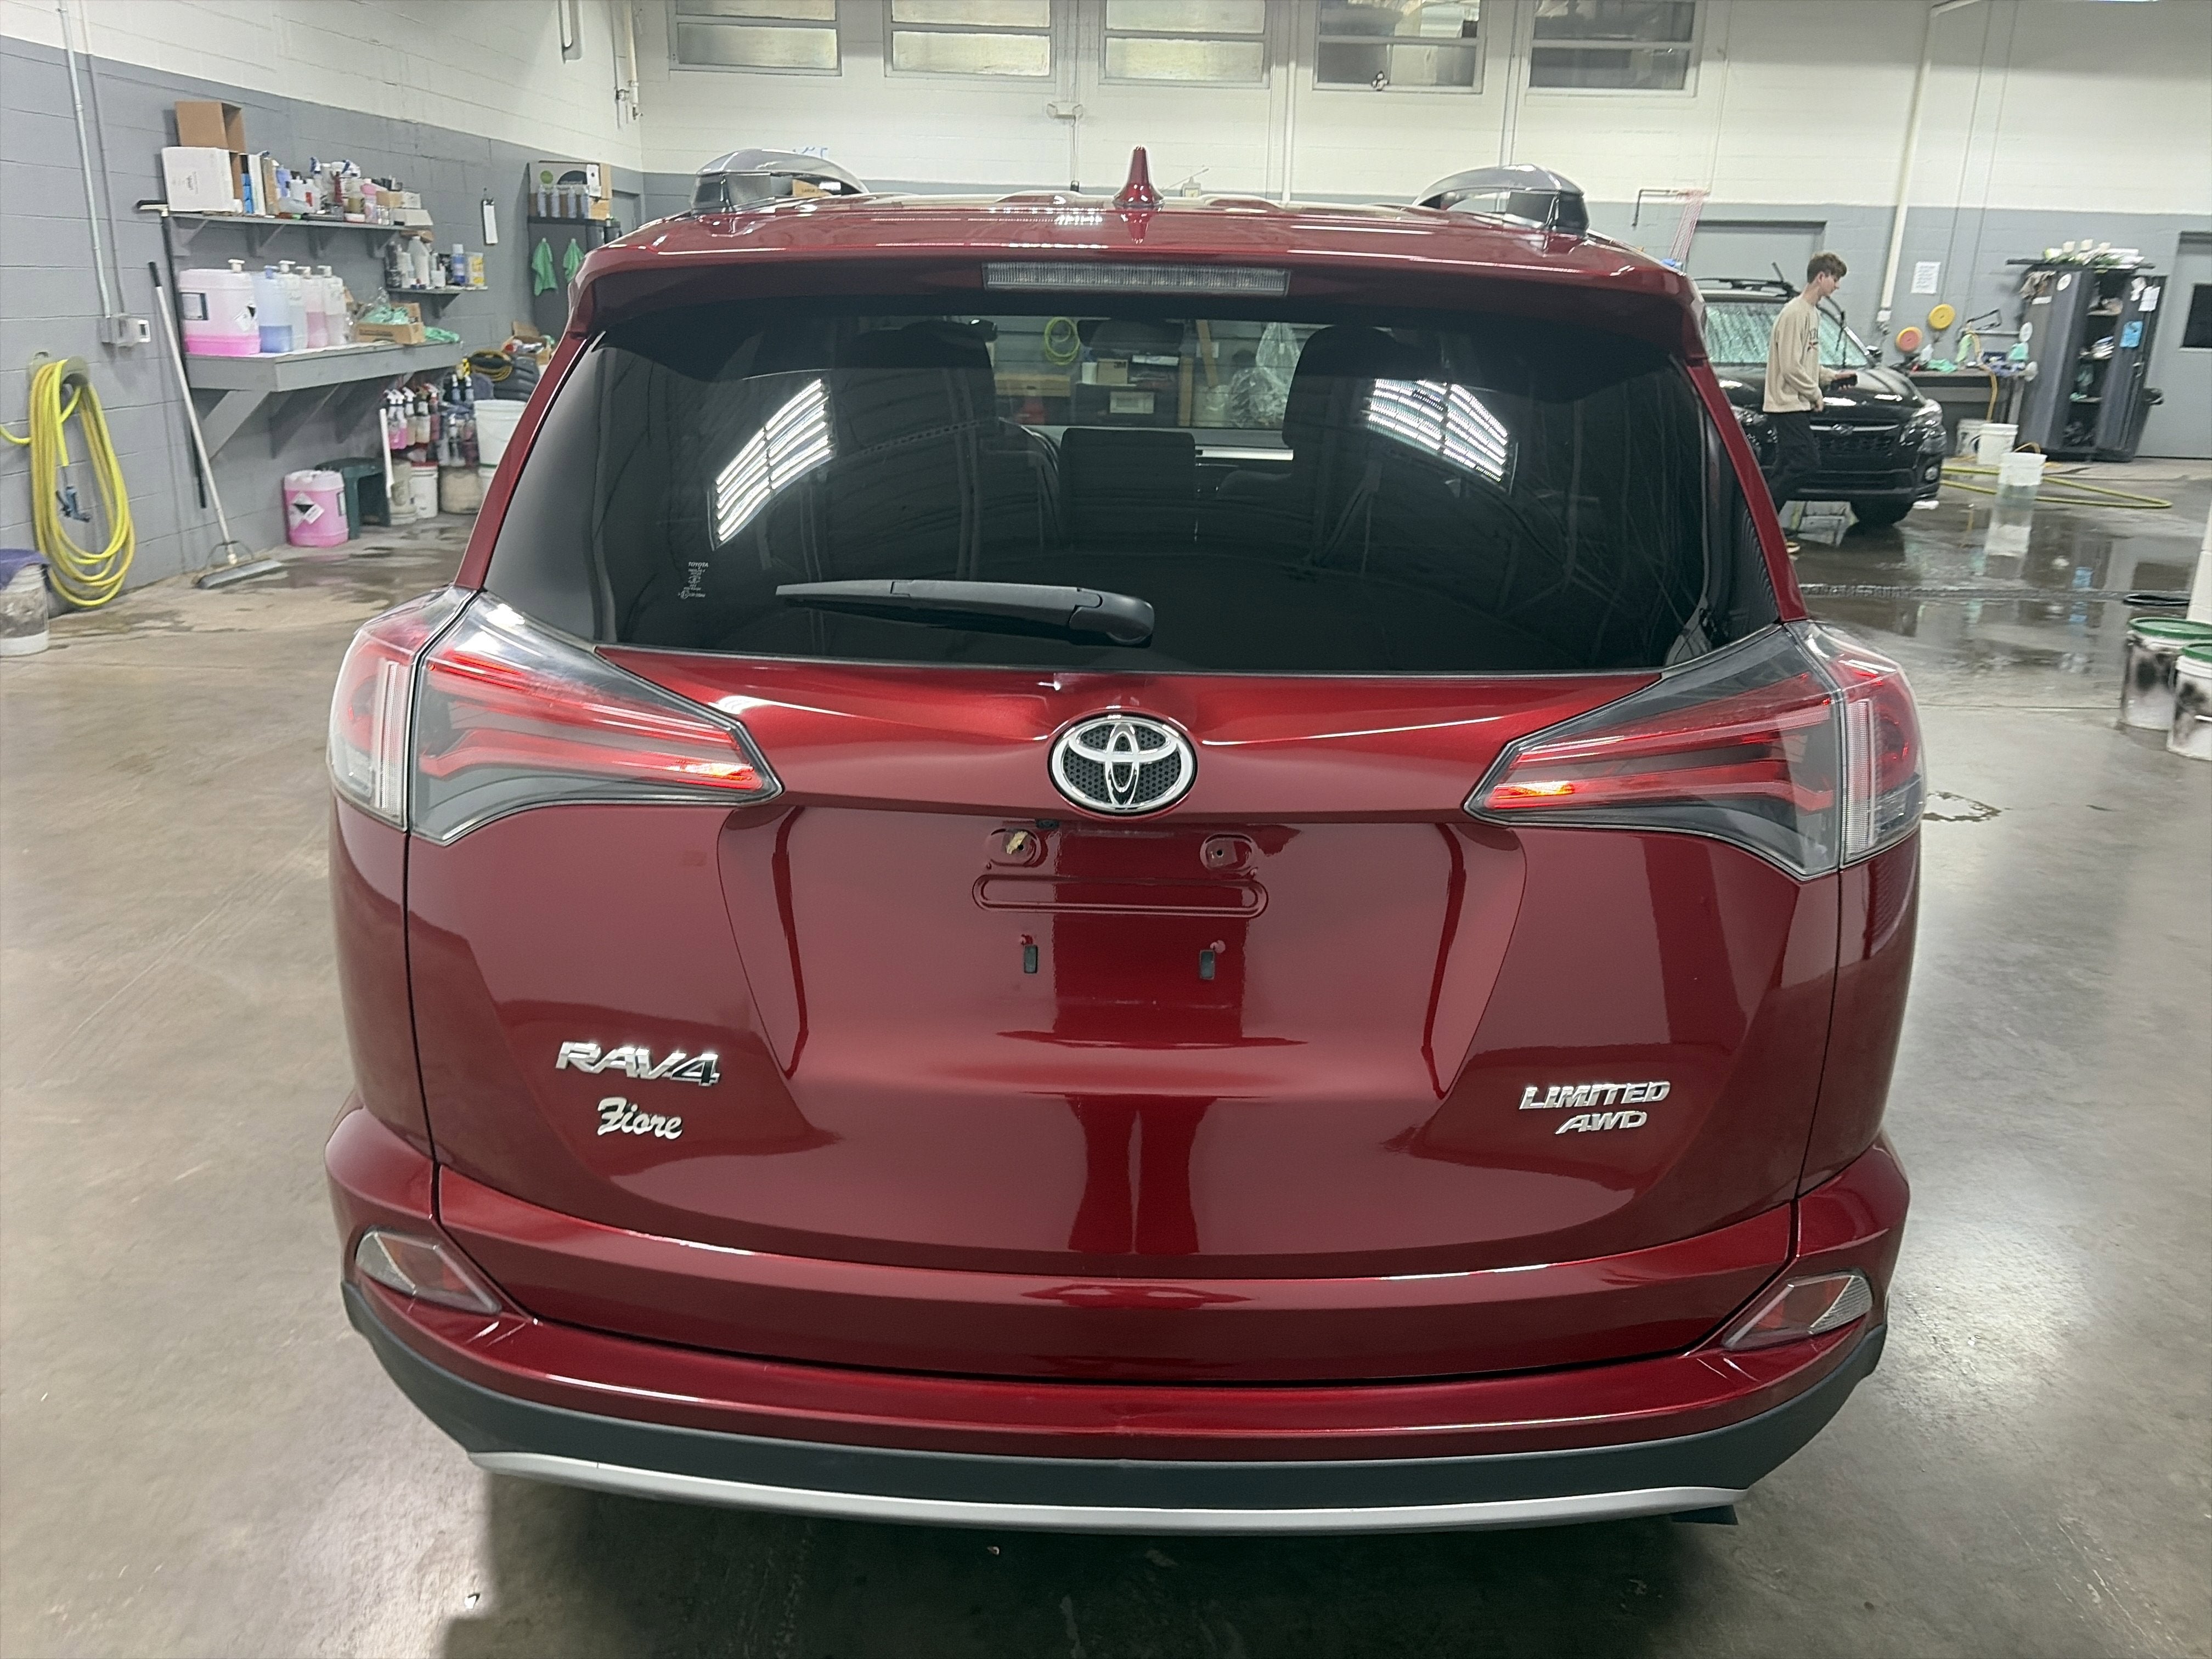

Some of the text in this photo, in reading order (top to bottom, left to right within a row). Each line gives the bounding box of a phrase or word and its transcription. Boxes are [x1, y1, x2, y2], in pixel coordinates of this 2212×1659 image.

[555, 1041, 720, 1086] RAV4
[1519, 1081, 1671, 1109] LIMITED
[597, 1097, 682, 1139] Fiore
[1554, 1111, 1647, 1135] AWD
